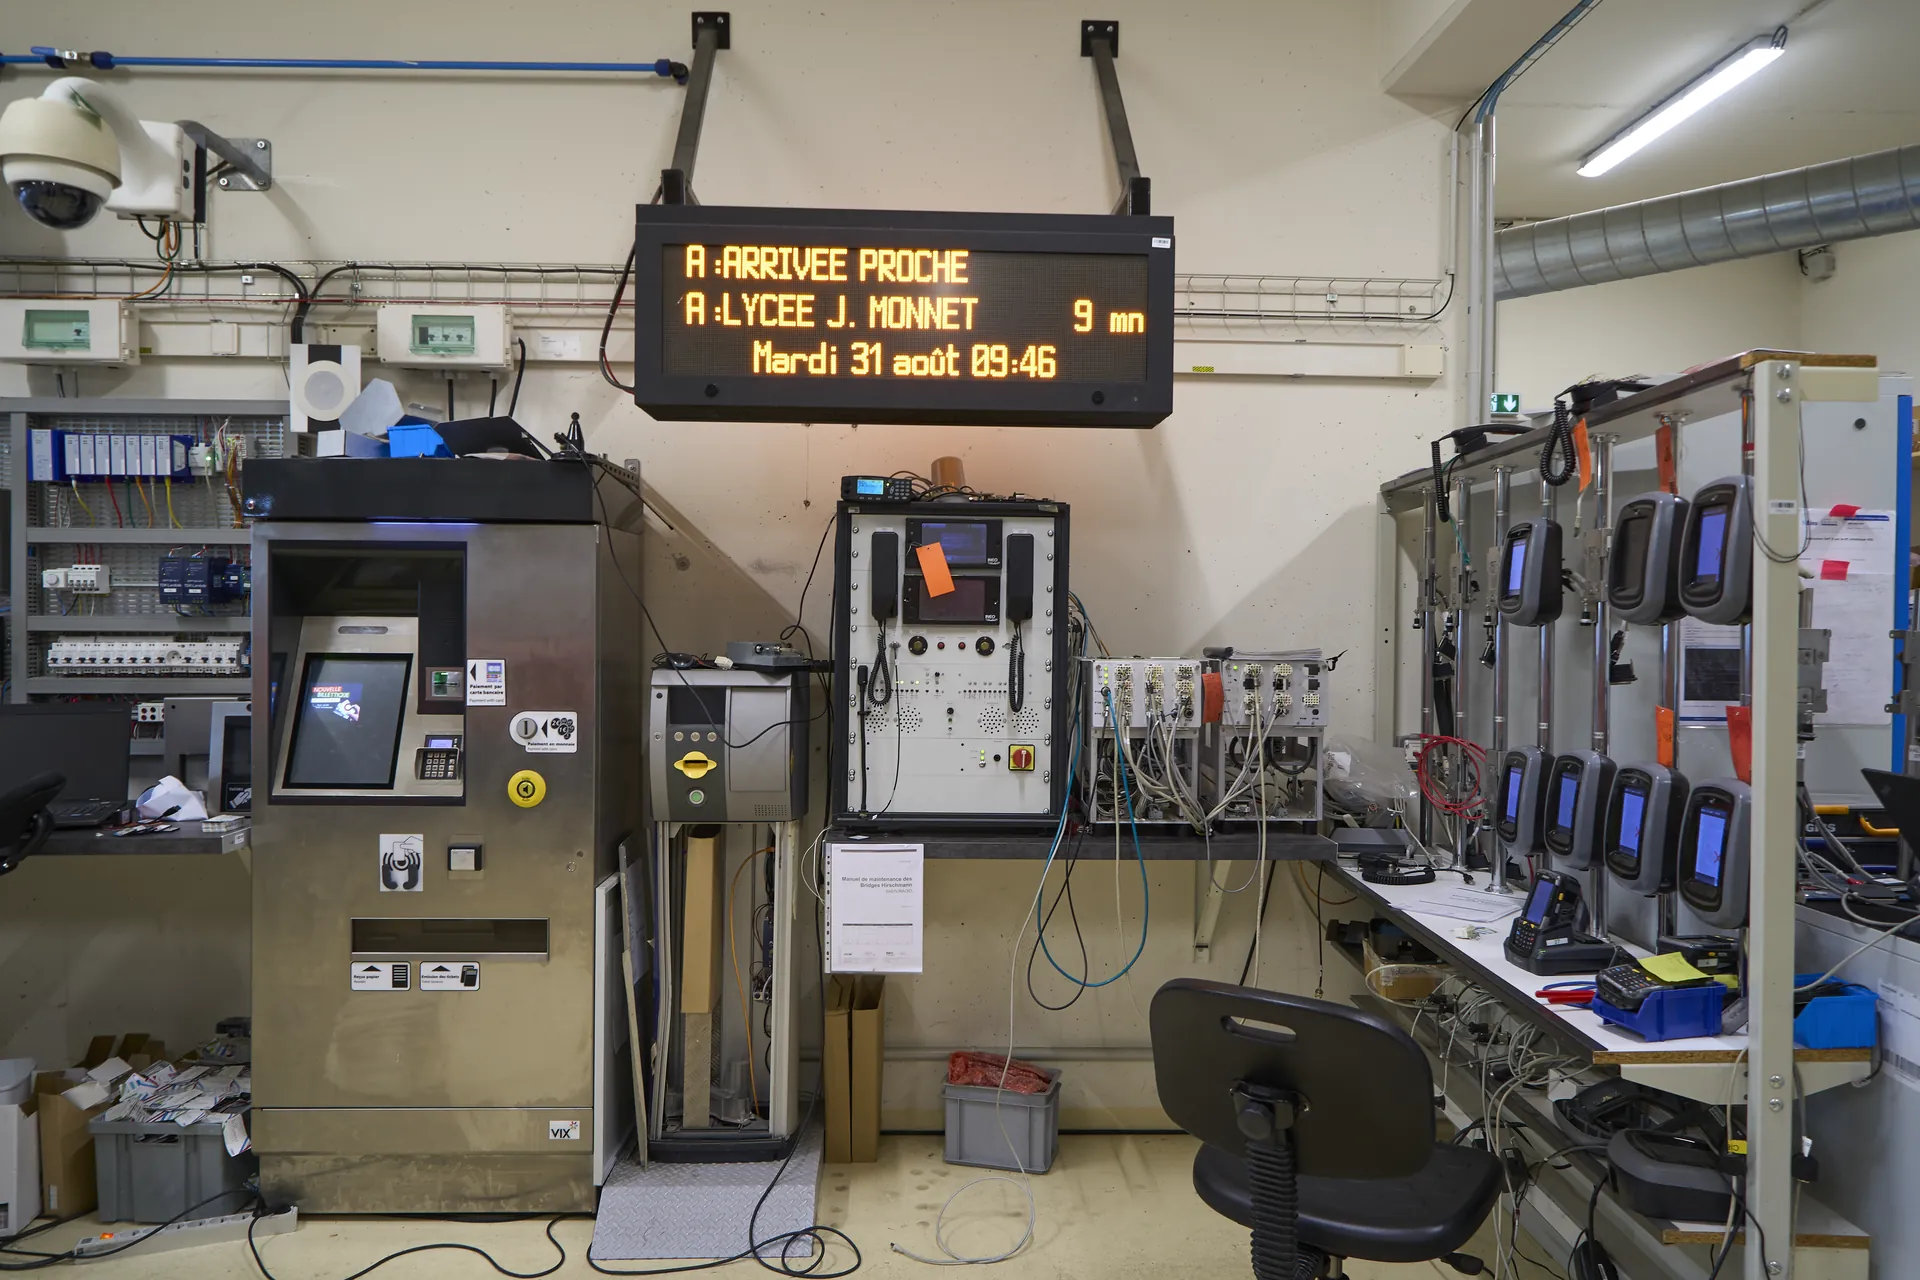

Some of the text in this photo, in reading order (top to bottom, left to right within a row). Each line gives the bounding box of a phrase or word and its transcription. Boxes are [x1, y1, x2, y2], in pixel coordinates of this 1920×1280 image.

[686, 244, 705, 278] A
[859, 248, 969, 285] PROCHE
[685, 291, 705, 326] A
[826, 294, 856, 328] J.
[869, 295, 979, 330] MONNET
[1073, 299, 1093, 332] 9
[1109, 312, 1145, 333] mn
[753, 340, 1056, 379] Mardi 31 août 09:46
[551, 1128, 571, 1139] VIX
